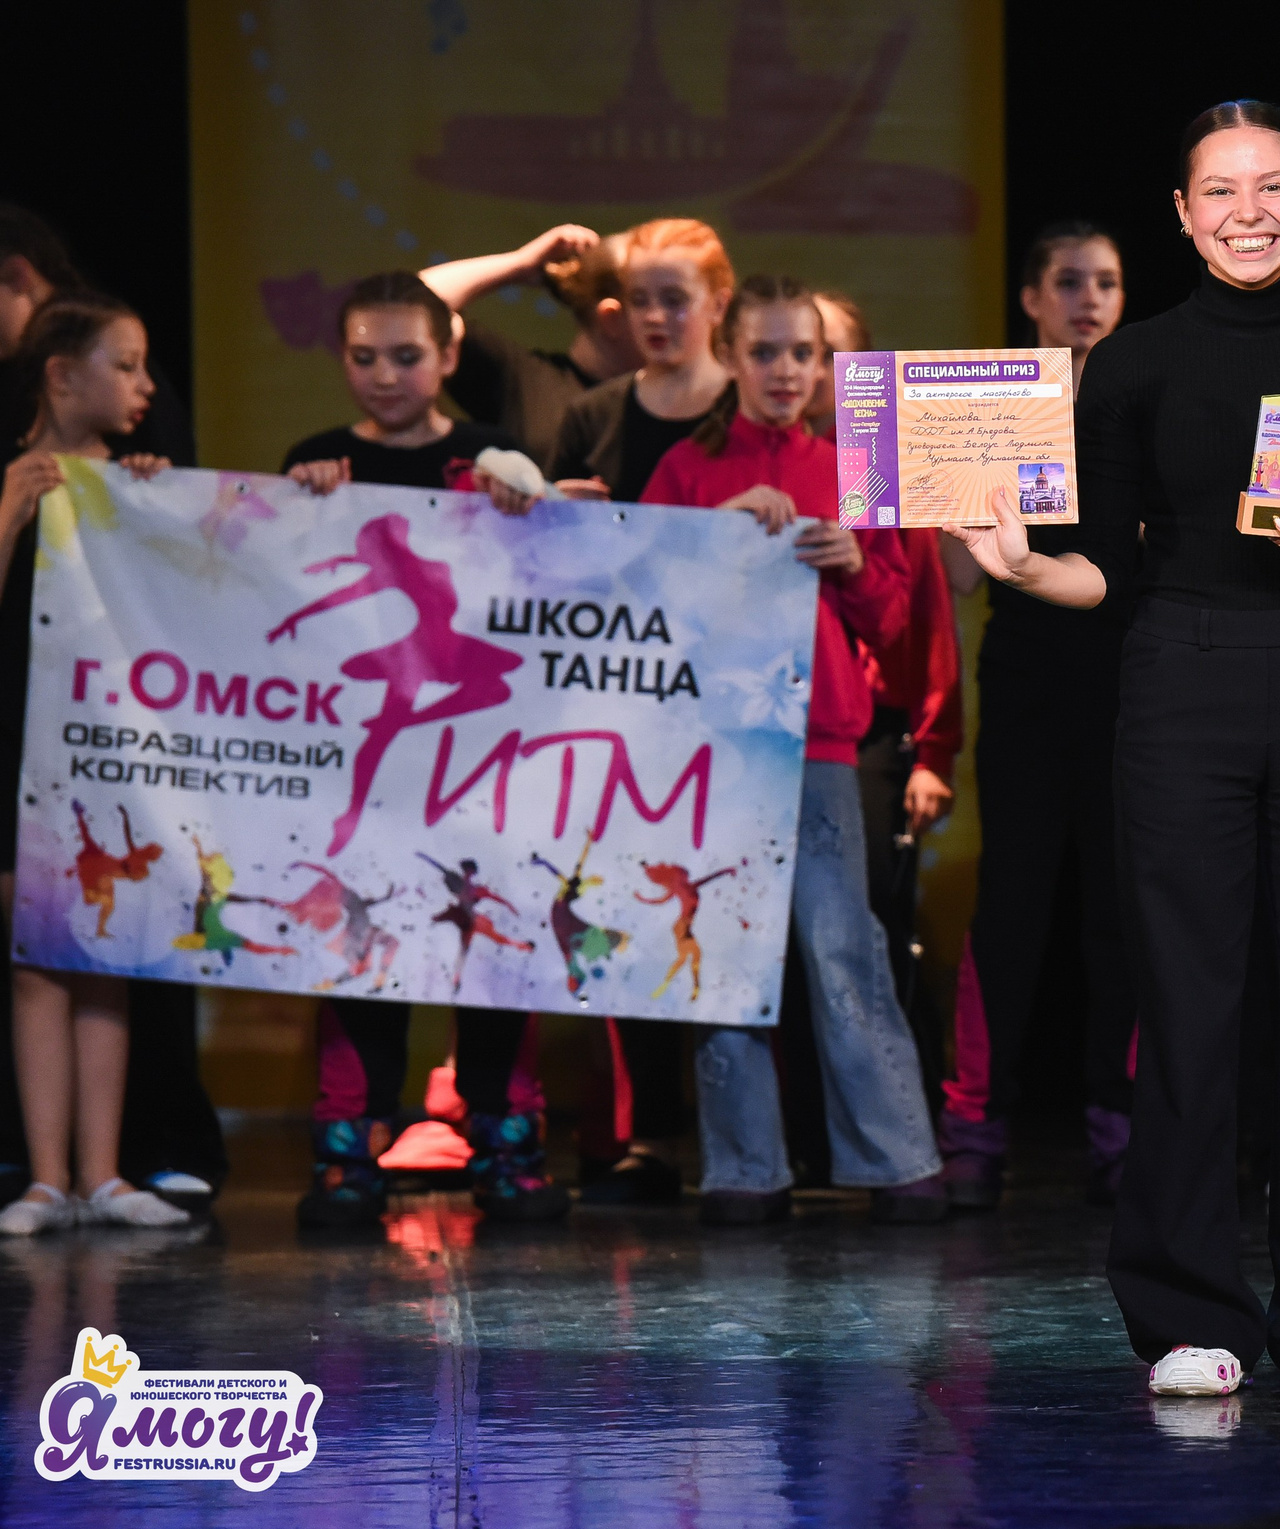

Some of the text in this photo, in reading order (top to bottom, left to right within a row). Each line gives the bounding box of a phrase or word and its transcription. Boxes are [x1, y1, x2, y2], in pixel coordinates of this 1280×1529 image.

[908, 362, 1035, 379] СПЕЦИАЛЬНЫЙ ПРИЗ
[909, 389, 921, 398] За
[980, 388, 1032, 399] мастерство
[916, 411, 982, 422] Михайлова
[1005, 439, 1055, 453] Людмила
[487, 596, 672, 644] ШКОЛА
[540, 651, 701, 703] ТАНЦА
[63, 722, 343, 769] ОБРАЗЦОВЫЙ
[70, 755, 311, 799] КОЛЛЕКТИВ
